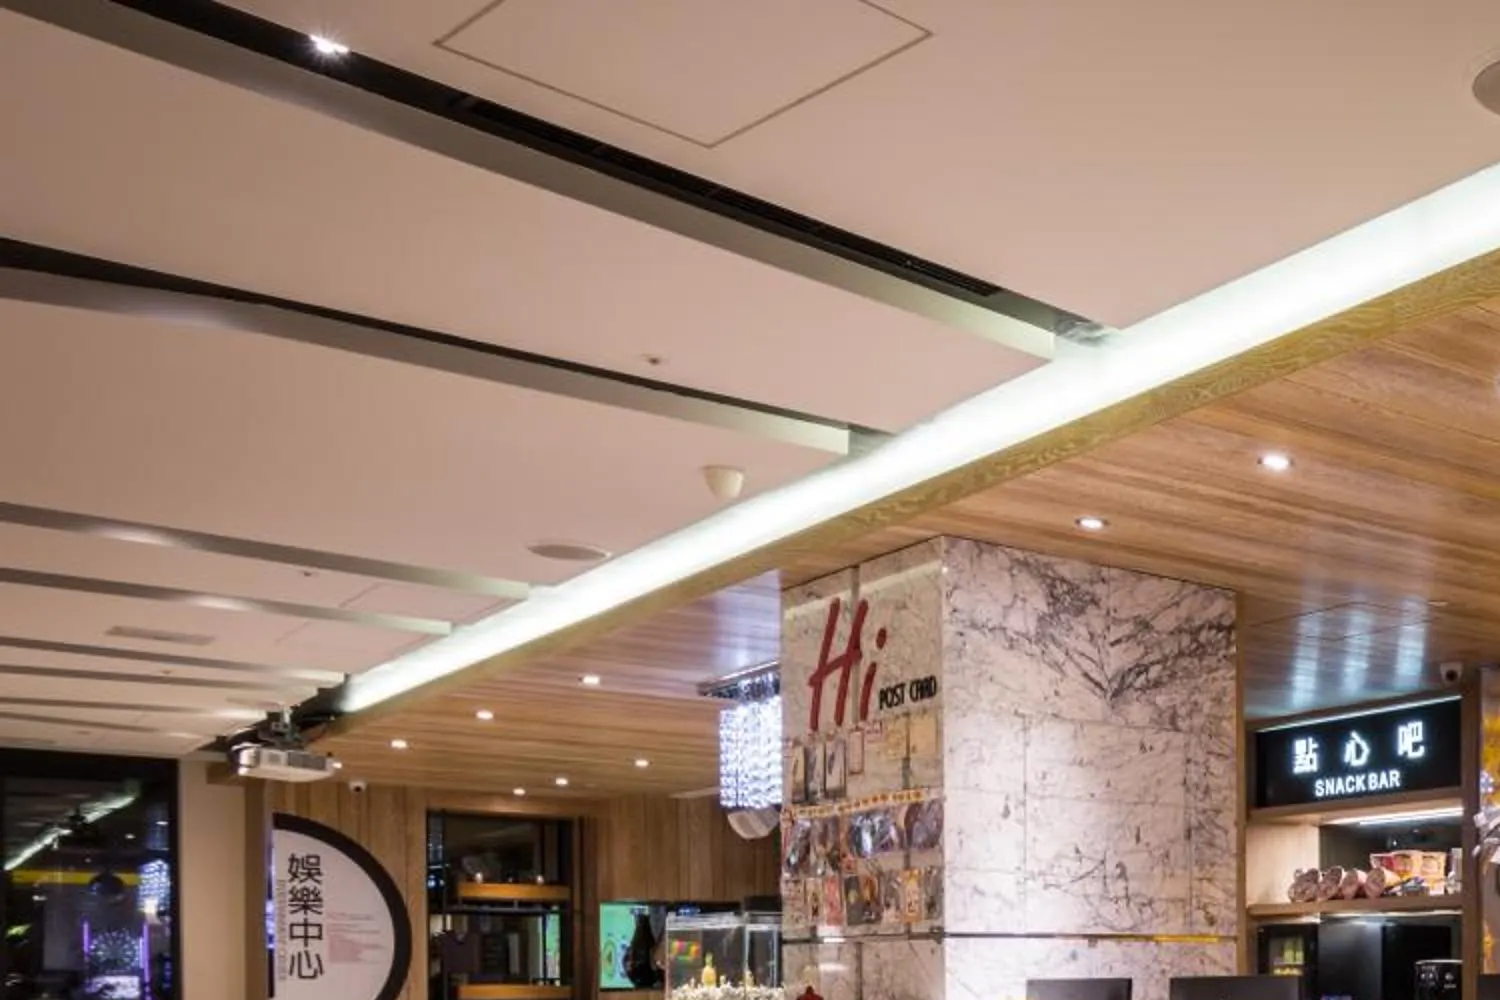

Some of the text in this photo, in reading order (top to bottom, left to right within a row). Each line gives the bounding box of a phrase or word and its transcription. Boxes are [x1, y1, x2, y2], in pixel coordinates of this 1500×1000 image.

[808, 597, 887, 731] Hi
[879, 682, 905, 711] POST
[1292, 720, 1426, 774] 點心吧
[1314, 769, 1401, 797] SNACK BAR
[288, 853, 324, 981] 娛樂中心
